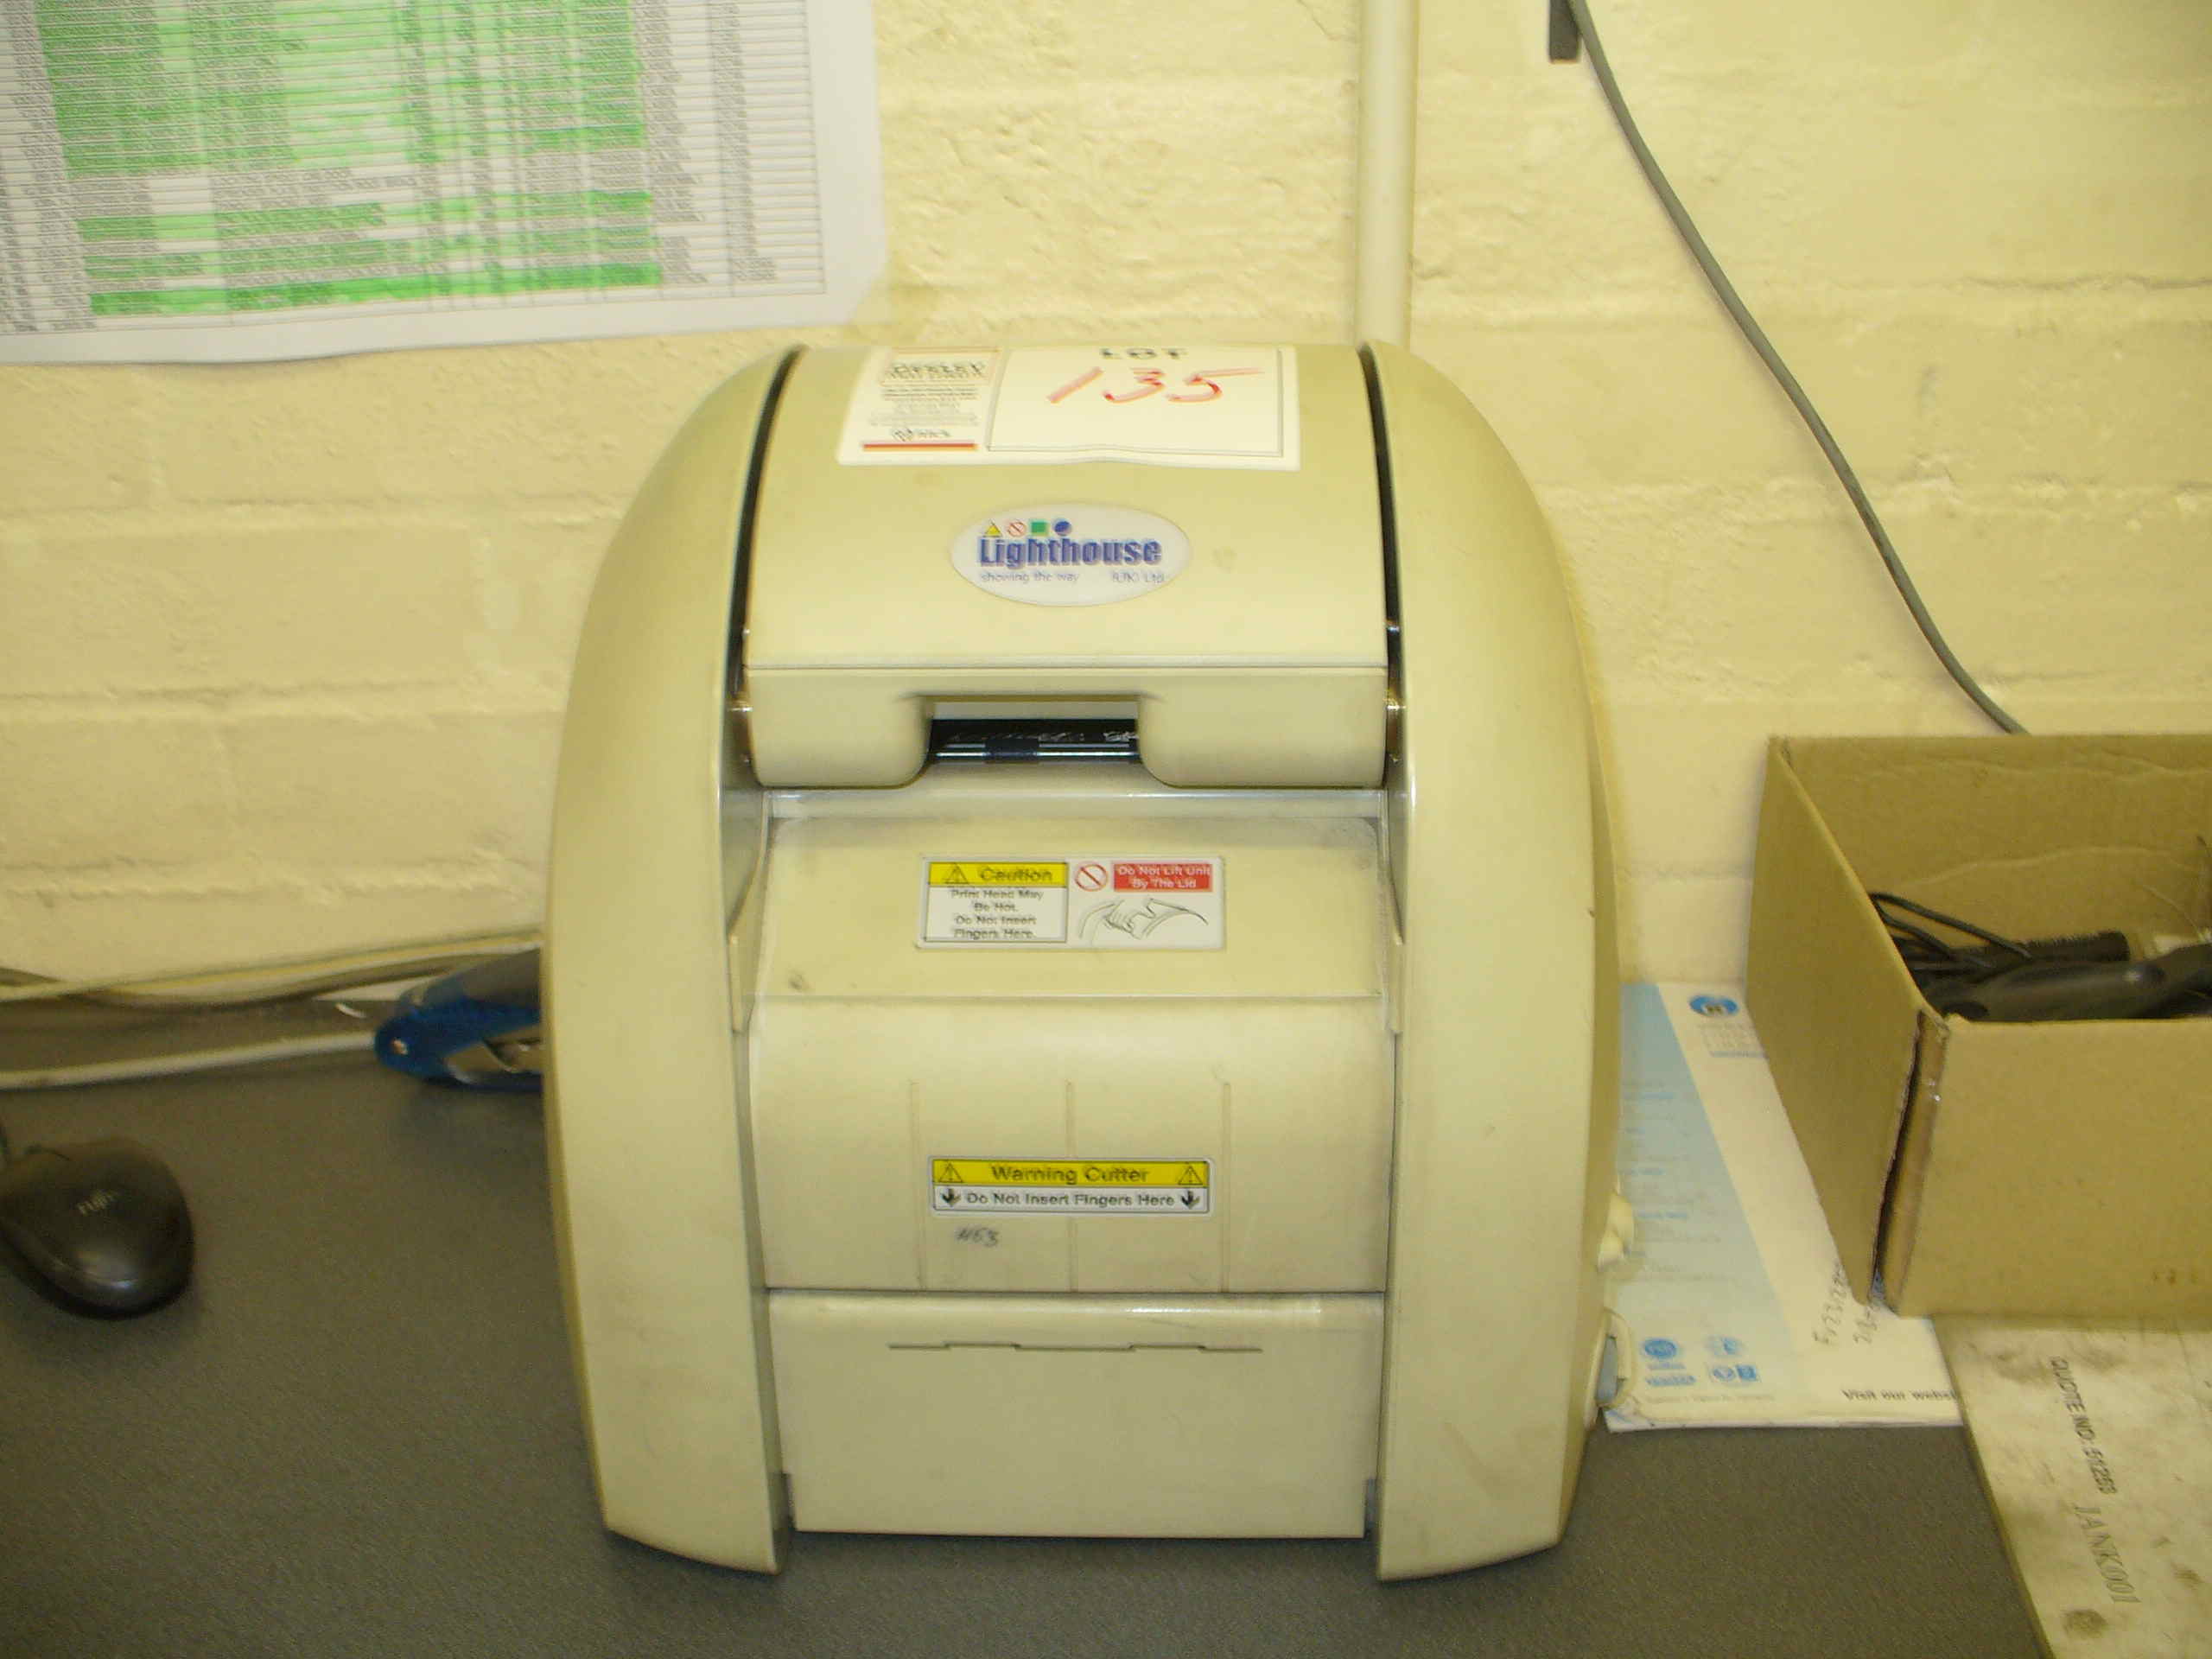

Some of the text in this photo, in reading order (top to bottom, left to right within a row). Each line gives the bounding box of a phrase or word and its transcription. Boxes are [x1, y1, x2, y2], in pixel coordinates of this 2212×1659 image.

[1100, 347, 1189, 359] LOT
[1046, 366, 1265, 404] 135
[980, 537, 1162, 570] Lighthouse
[981, 571, 1030, 583] showing
[1033, 571, 1052, 582] the
[1057, 573, 1079, 583] way
[979, 867, 1052, 882] Caution
[1119, 864, 1211, 876] Do Not Lift Unit
[1133, 877, 1197, 890] By The Lid
[951, 888, 1044, 901] Print Head May
[973, 901, 990, 912] Be
[956, 915, 1037, 925] Do Not Insert
[955, 928, 998, 941] Fingers
[992, 1166, 1149, 1185] Warning Cutter
[967, 1192, 1175, 1207] Do Not Insert Fingers Here
[2049, 1356, 2087, 1414] QUOTE
[1841, 1389, 1877, 1402] Visit
[1880, 1389, 1904, 1401] our
